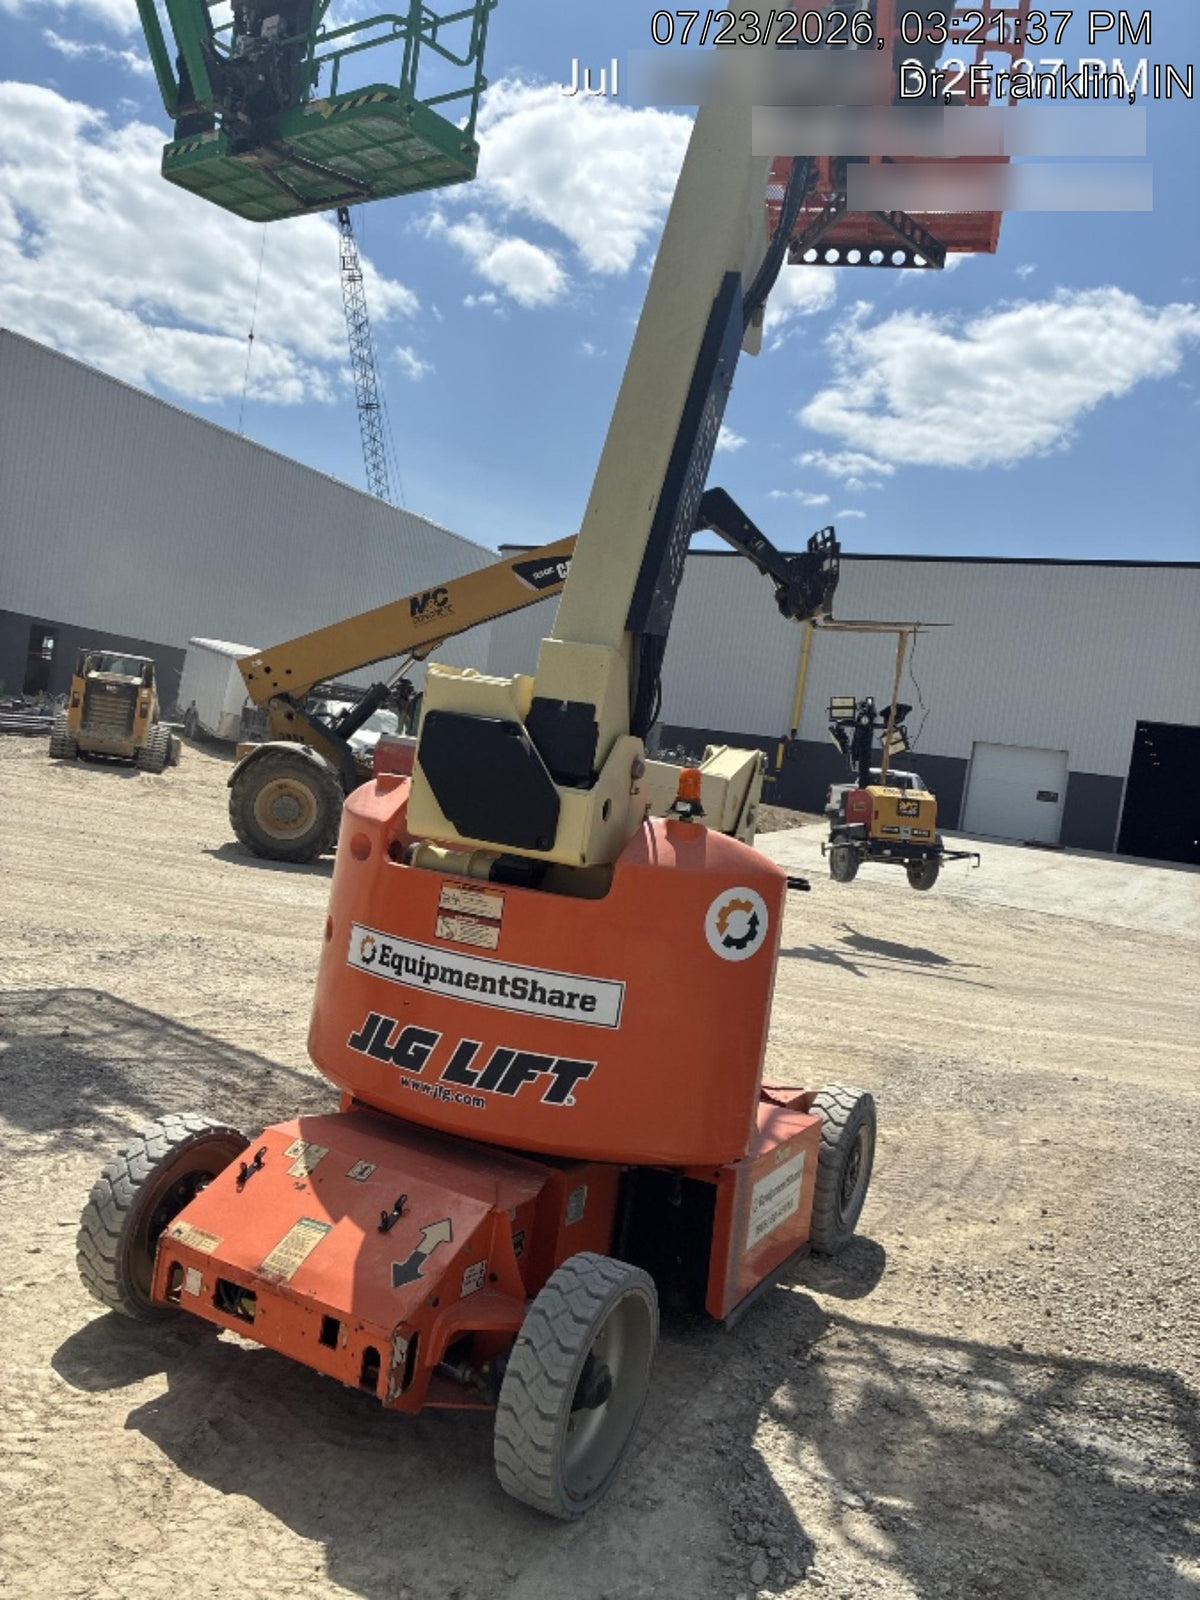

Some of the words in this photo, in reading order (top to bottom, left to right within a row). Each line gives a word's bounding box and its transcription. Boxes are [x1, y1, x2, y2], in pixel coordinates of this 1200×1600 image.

[378, 944, 598, 1013] EquipmentShare
[347, 1011, 441, 1073] JLG
[440, 1039, 598, 1106] LIFT
[400, 1076, 486, 1109] www.jlg.com
